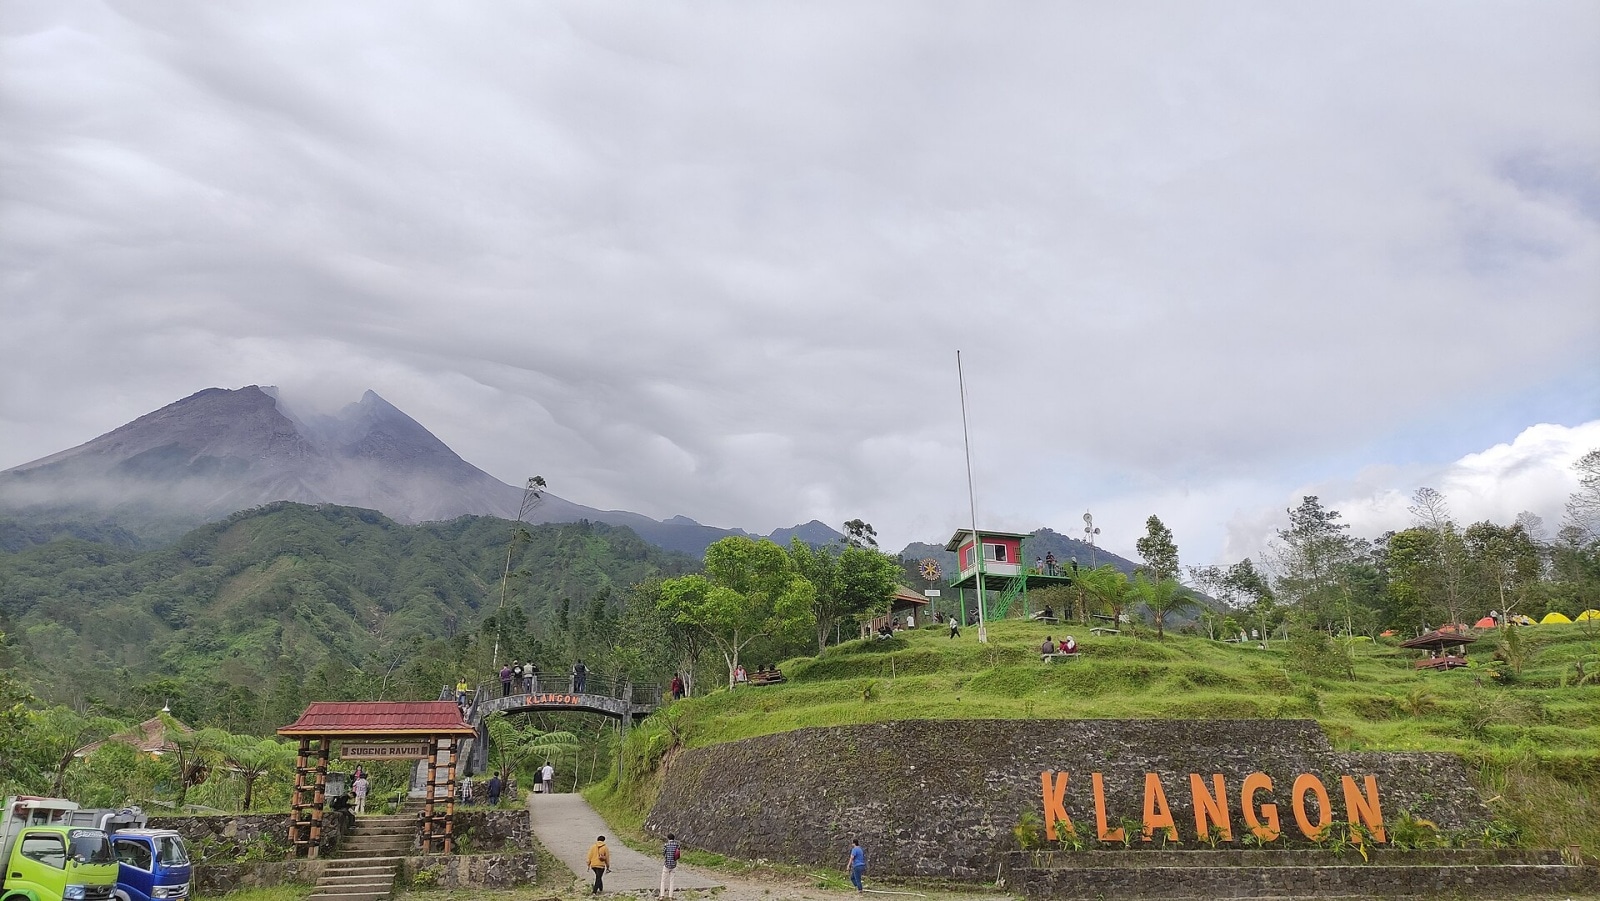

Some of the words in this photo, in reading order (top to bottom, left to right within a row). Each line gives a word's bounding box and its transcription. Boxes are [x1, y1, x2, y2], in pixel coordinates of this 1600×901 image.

[526, 693, 579, 705] KLANGON
[350, 747, 387, 755] SUGENG
[1041, 771, 1386, 844] KLANGON
